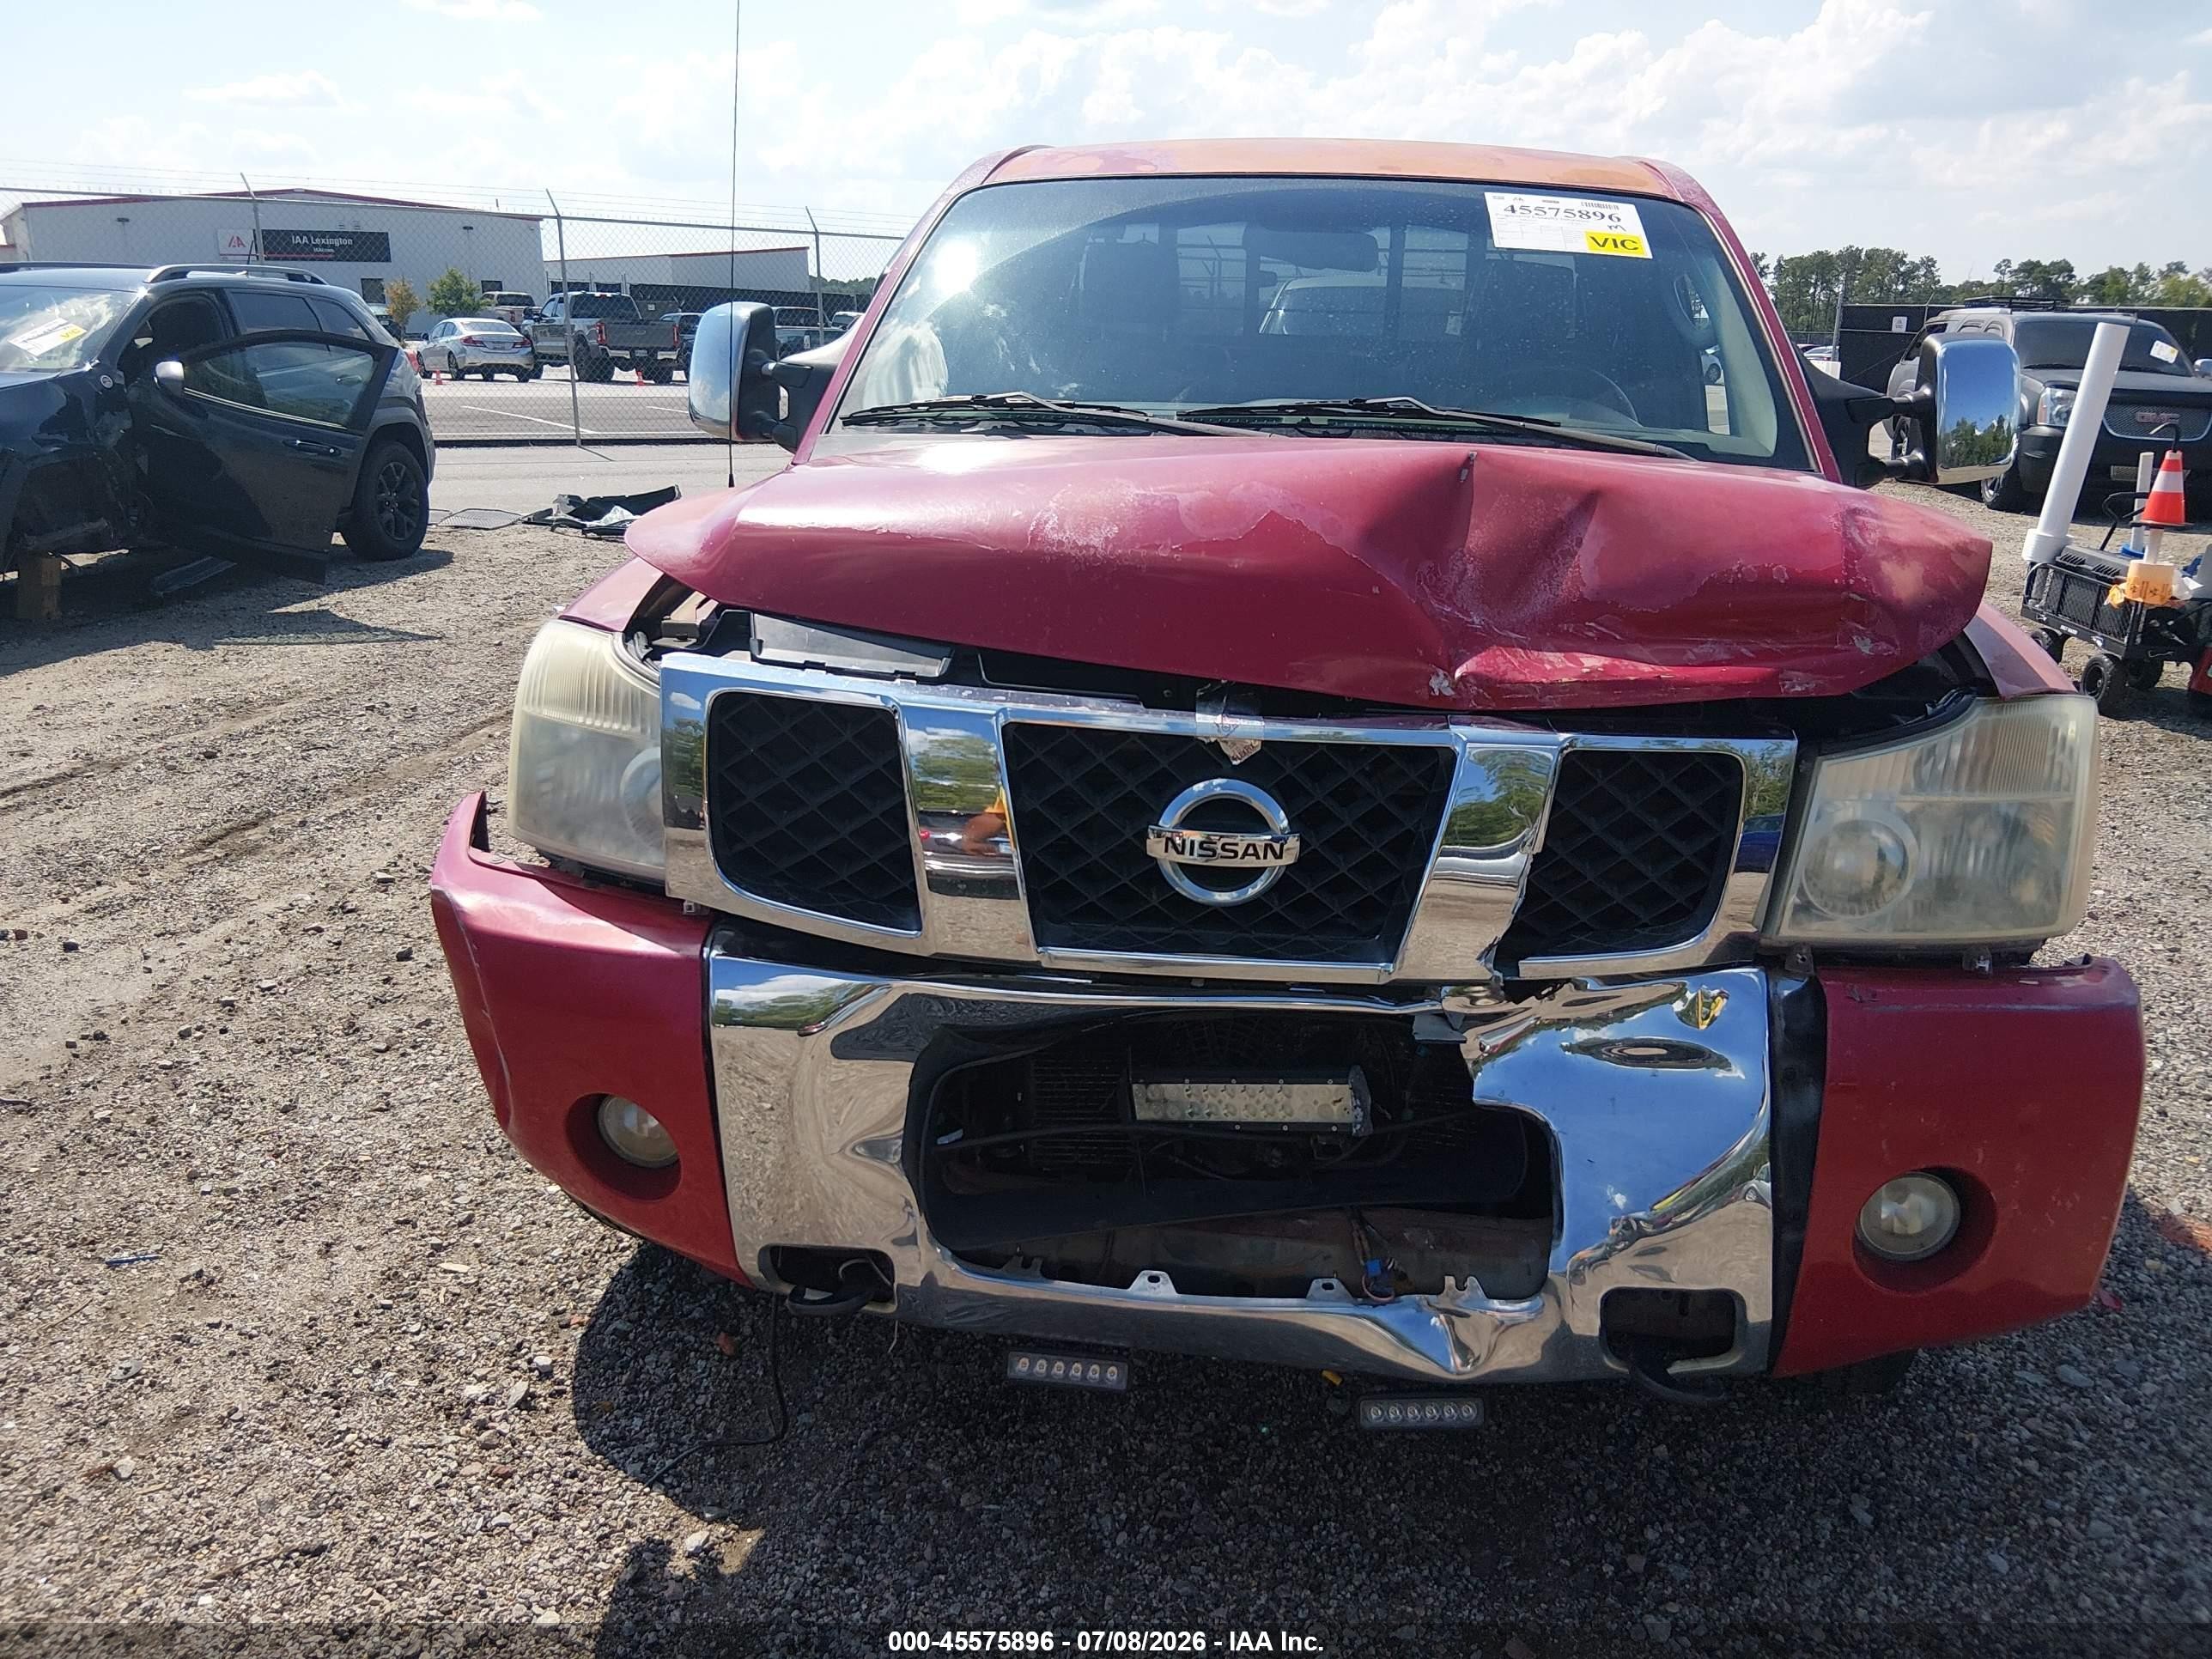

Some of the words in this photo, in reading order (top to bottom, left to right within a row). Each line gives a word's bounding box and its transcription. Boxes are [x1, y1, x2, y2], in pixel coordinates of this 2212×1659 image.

[1504, 204, 1621, 222] 45575896
[292, 235, 309, 245] IAA
[311, 235, 354, 247] Lexington
[1589, 235, 1639, 251] VIC
[2136, 412, 2181, 423] GMC
[1164, 836, 1285, 860] NISSAN
